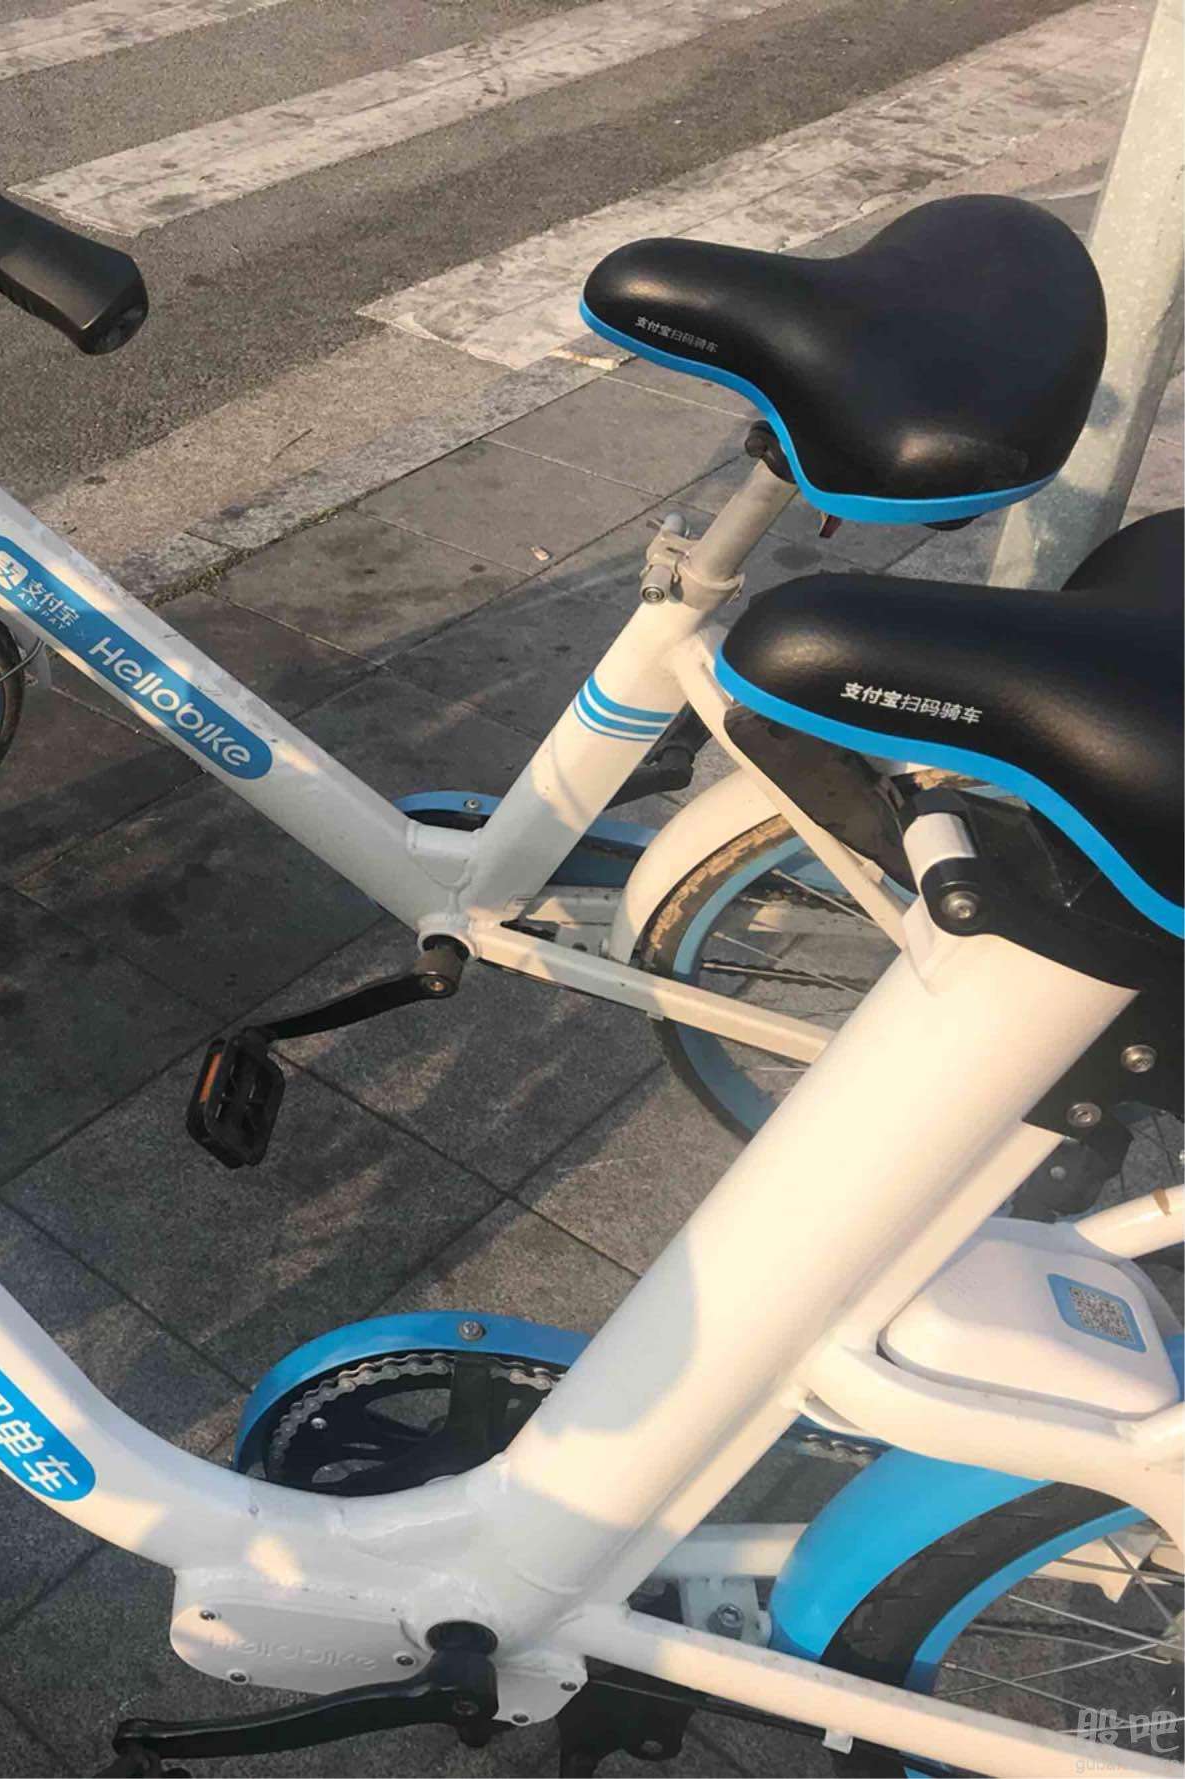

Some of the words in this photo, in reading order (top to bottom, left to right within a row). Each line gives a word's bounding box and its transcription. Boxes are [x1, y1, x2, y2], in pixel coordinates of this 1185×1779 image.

[635, 316, 718, 352] 支付宝扫码骑车
[17, 593, 68, 631] ALIPAY
[23, 580, 81, 625] 支付宝
[88, 636, 251, 766] Hellobike
[840, 682, 982, 724] 支付宝扫码骑车
